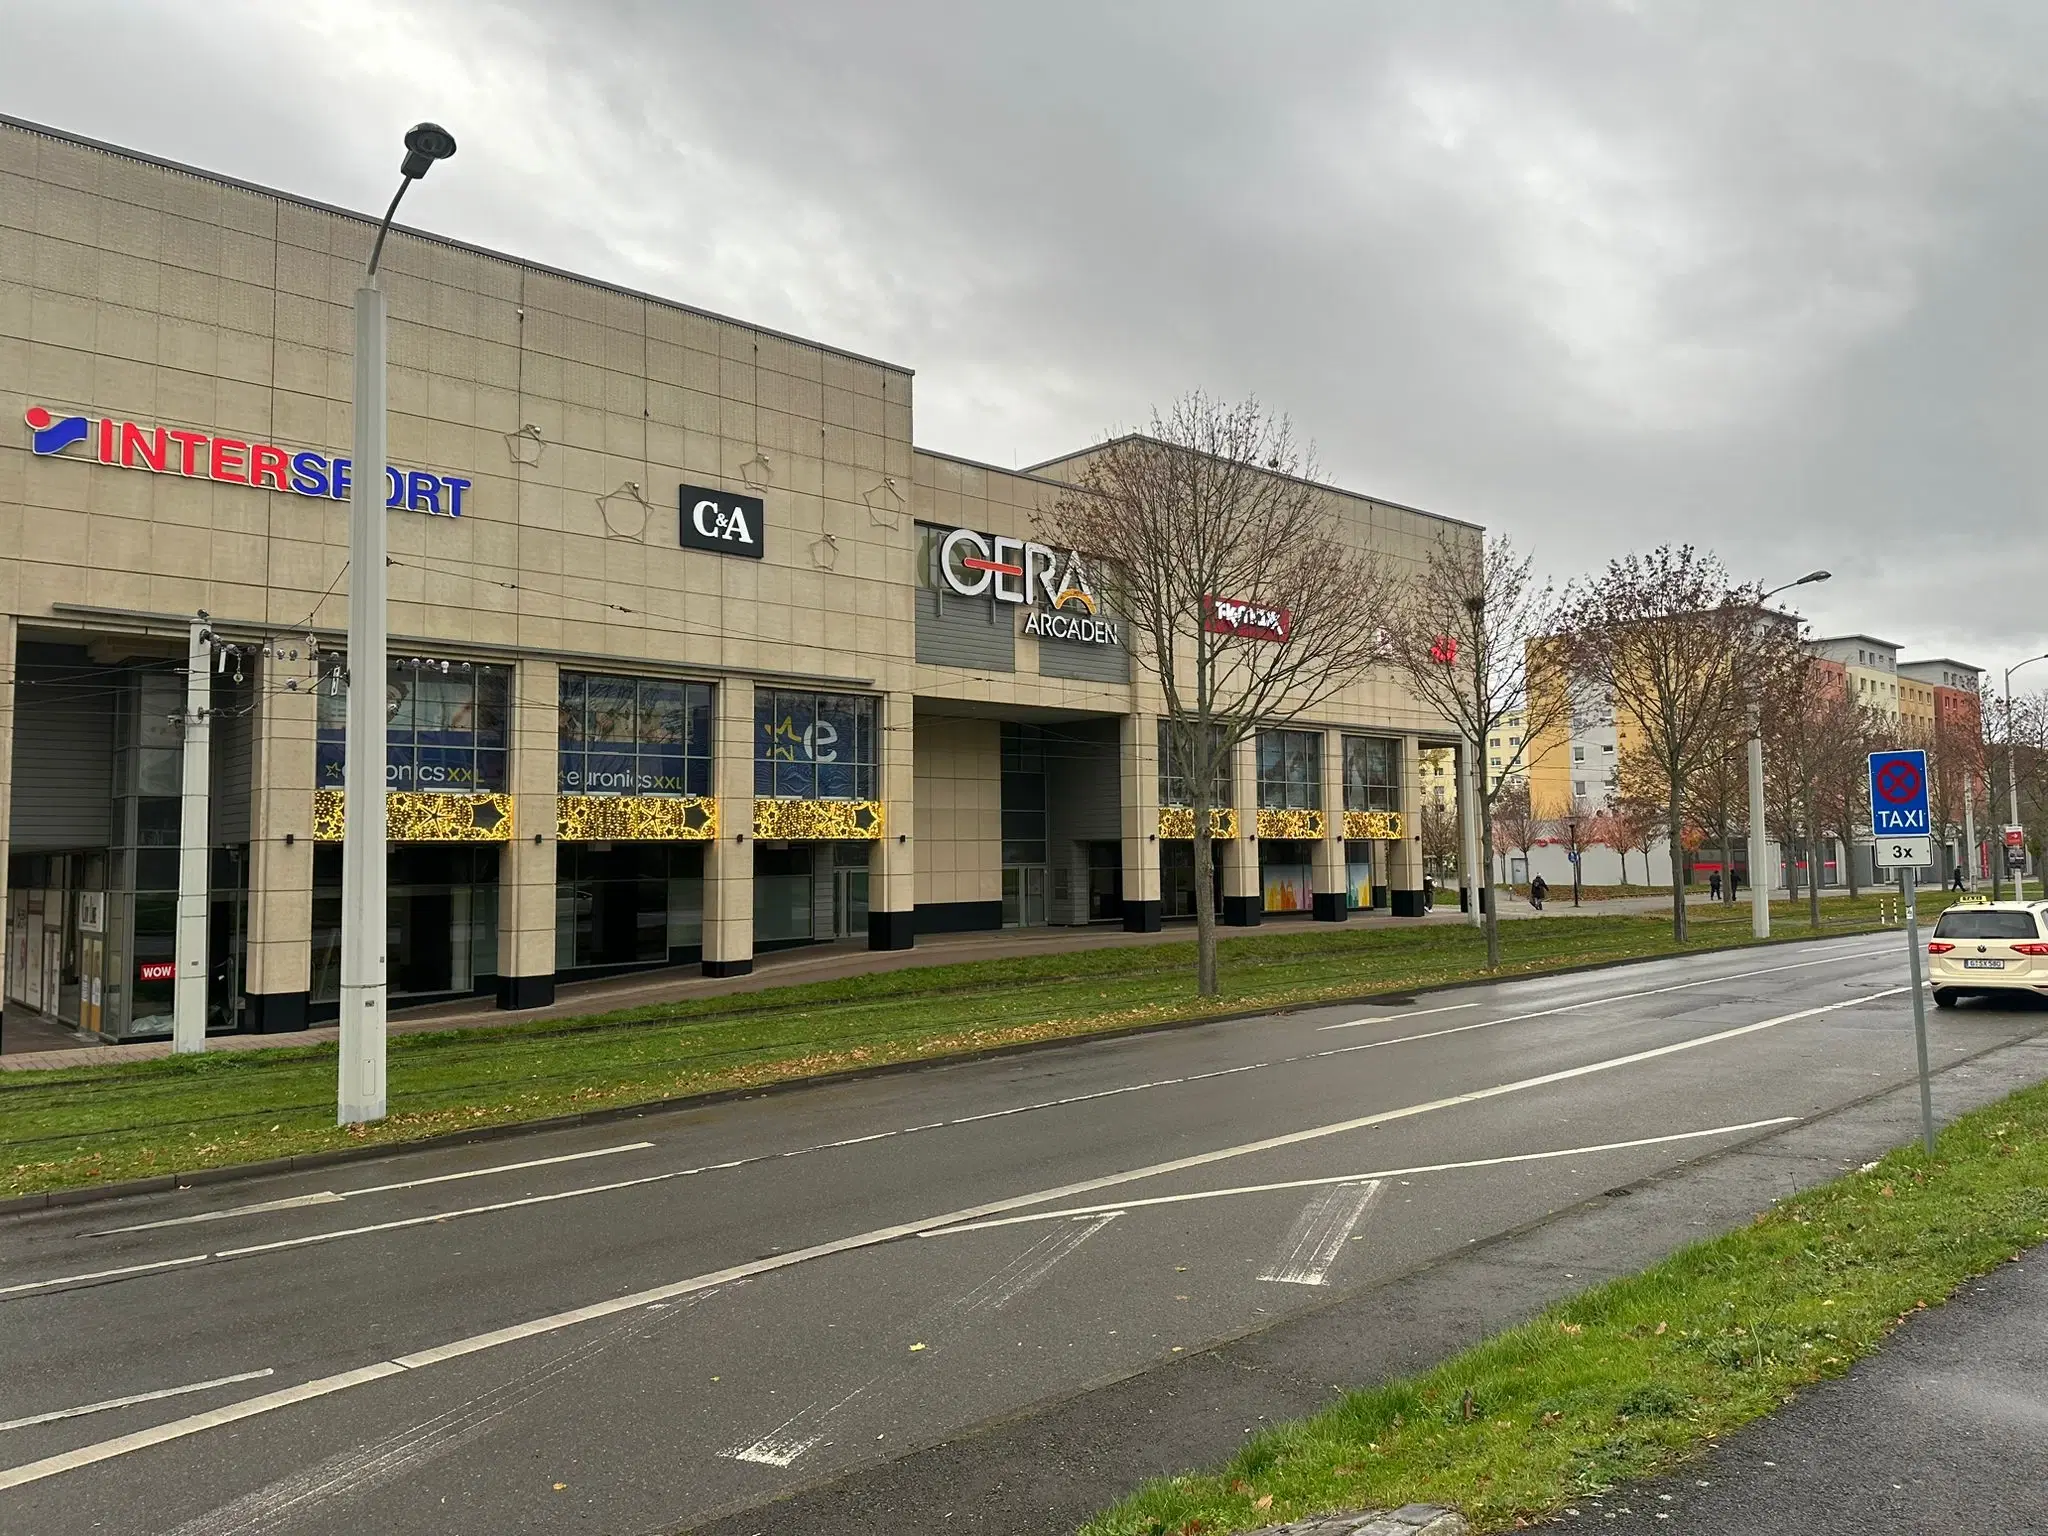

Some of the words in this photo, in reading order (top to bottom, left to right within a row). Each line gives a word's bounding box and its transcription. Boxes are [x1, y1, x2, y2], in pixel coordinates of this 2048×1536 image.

[693, 500, 754, 544] C&A
[941, 529, 1097, 615] GERA
[1024, 612, 1118, 645] ARCADEN
[1878, 810, 1924, 828] TAXI
[1892, 845, 1913, 858] 3x
[143, 966, 171, 978] WOW
